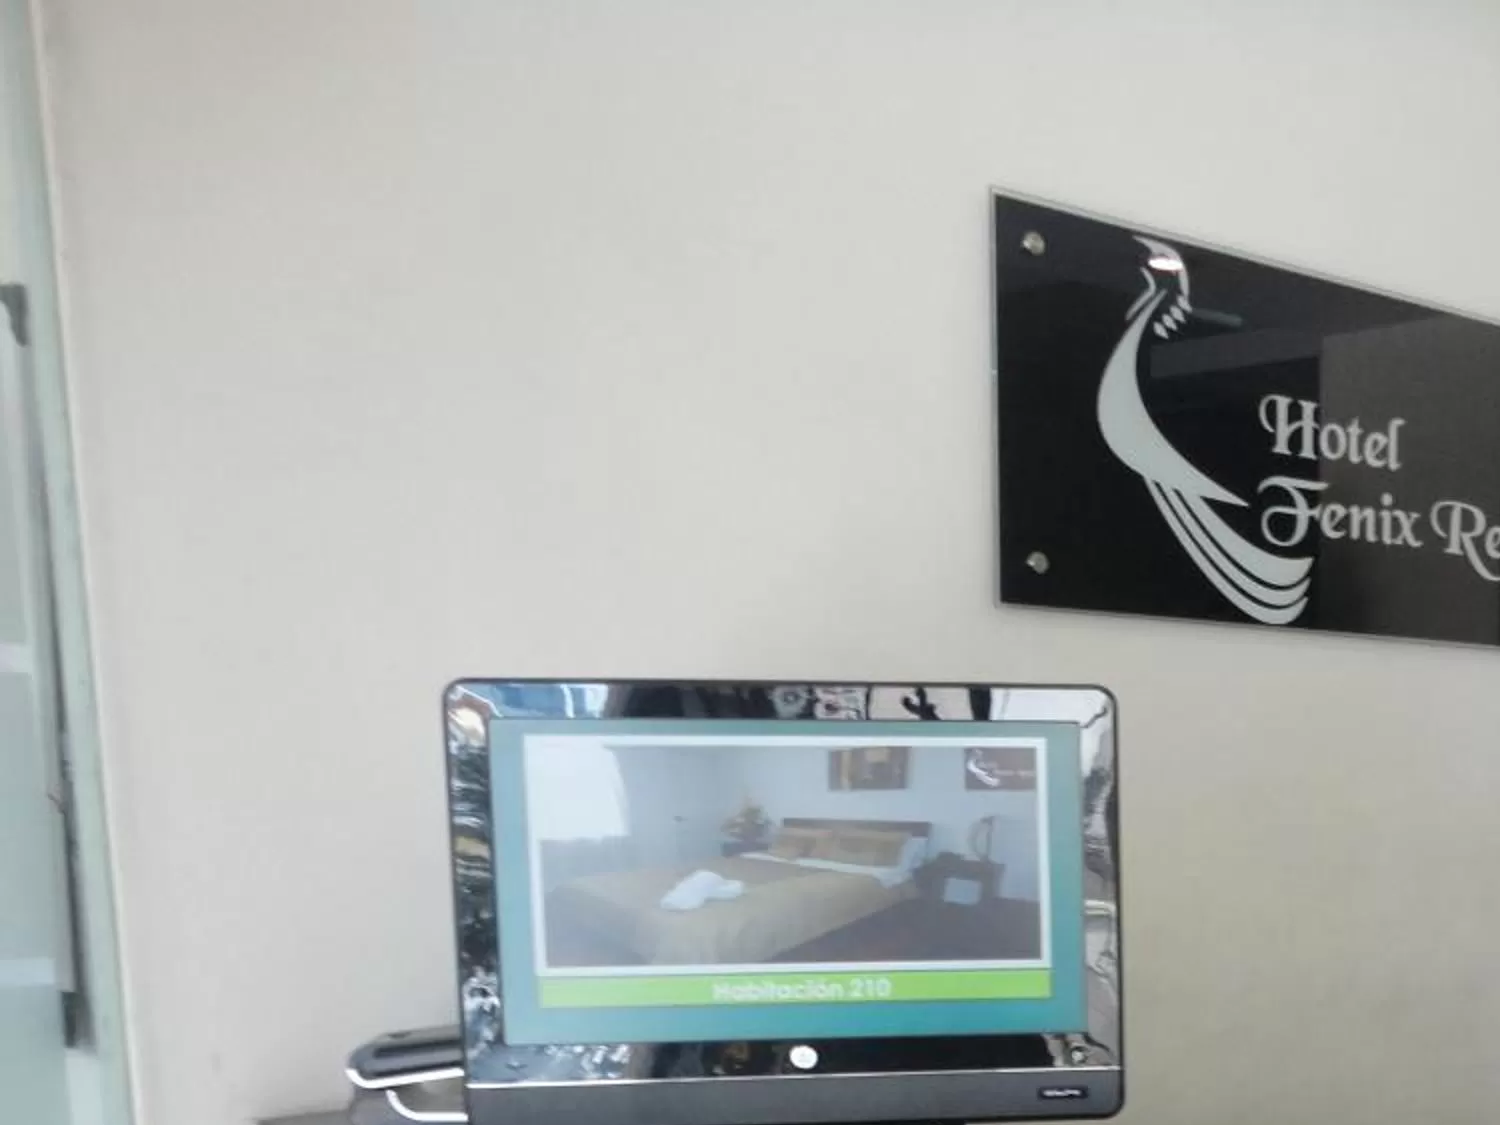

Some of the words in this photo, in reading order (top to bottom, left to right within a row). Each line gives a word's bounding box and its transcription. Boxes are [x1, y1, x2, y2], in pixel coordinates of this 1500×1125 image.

[1258, 394, 1405, 470] Hotel
[1257, 476, 1422, 546] Fenix
[849, 977, 892, 998] 210
